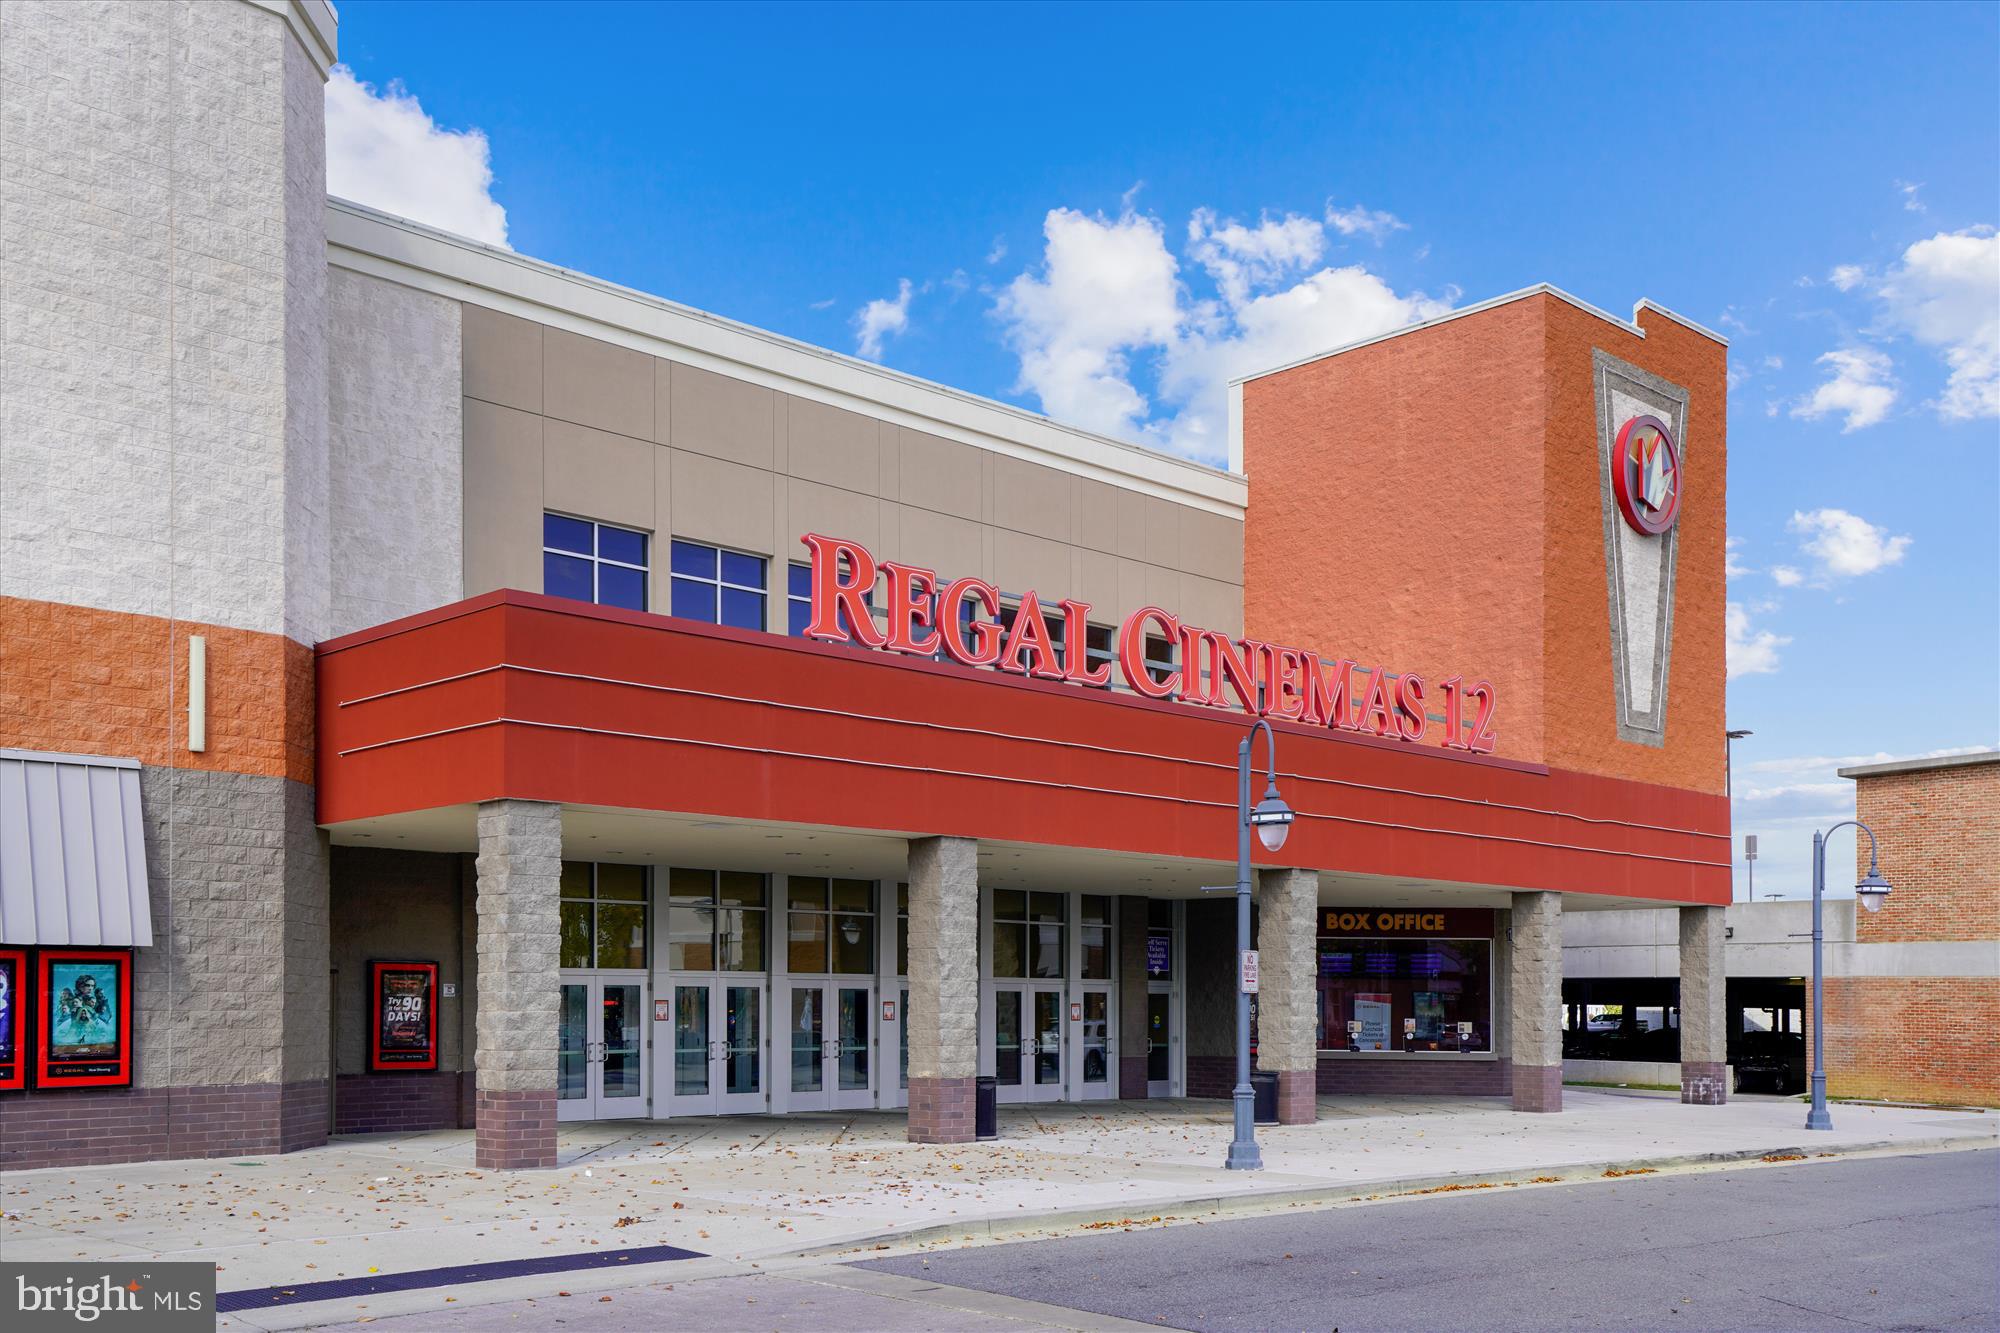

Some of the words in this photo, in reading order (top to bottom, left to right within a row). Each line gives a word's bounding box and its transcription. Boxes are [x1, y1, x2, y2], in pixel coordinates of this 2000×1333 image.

[800, 532, 1111, 685] REGAL
[1119, 606, 1427, 742] CINEMAS
[1440, 674, 1497, 754] 12
[1326, 913, 1371, 930] BOX
[1377, 913, 1445, 931] OFFICE
[1247, 954, 1253, 964] NO
[388, 997, 402, 1006] Try
[402, 996, 422, 1011] 90
[388, 1011, 421, 1021] DAYS!
